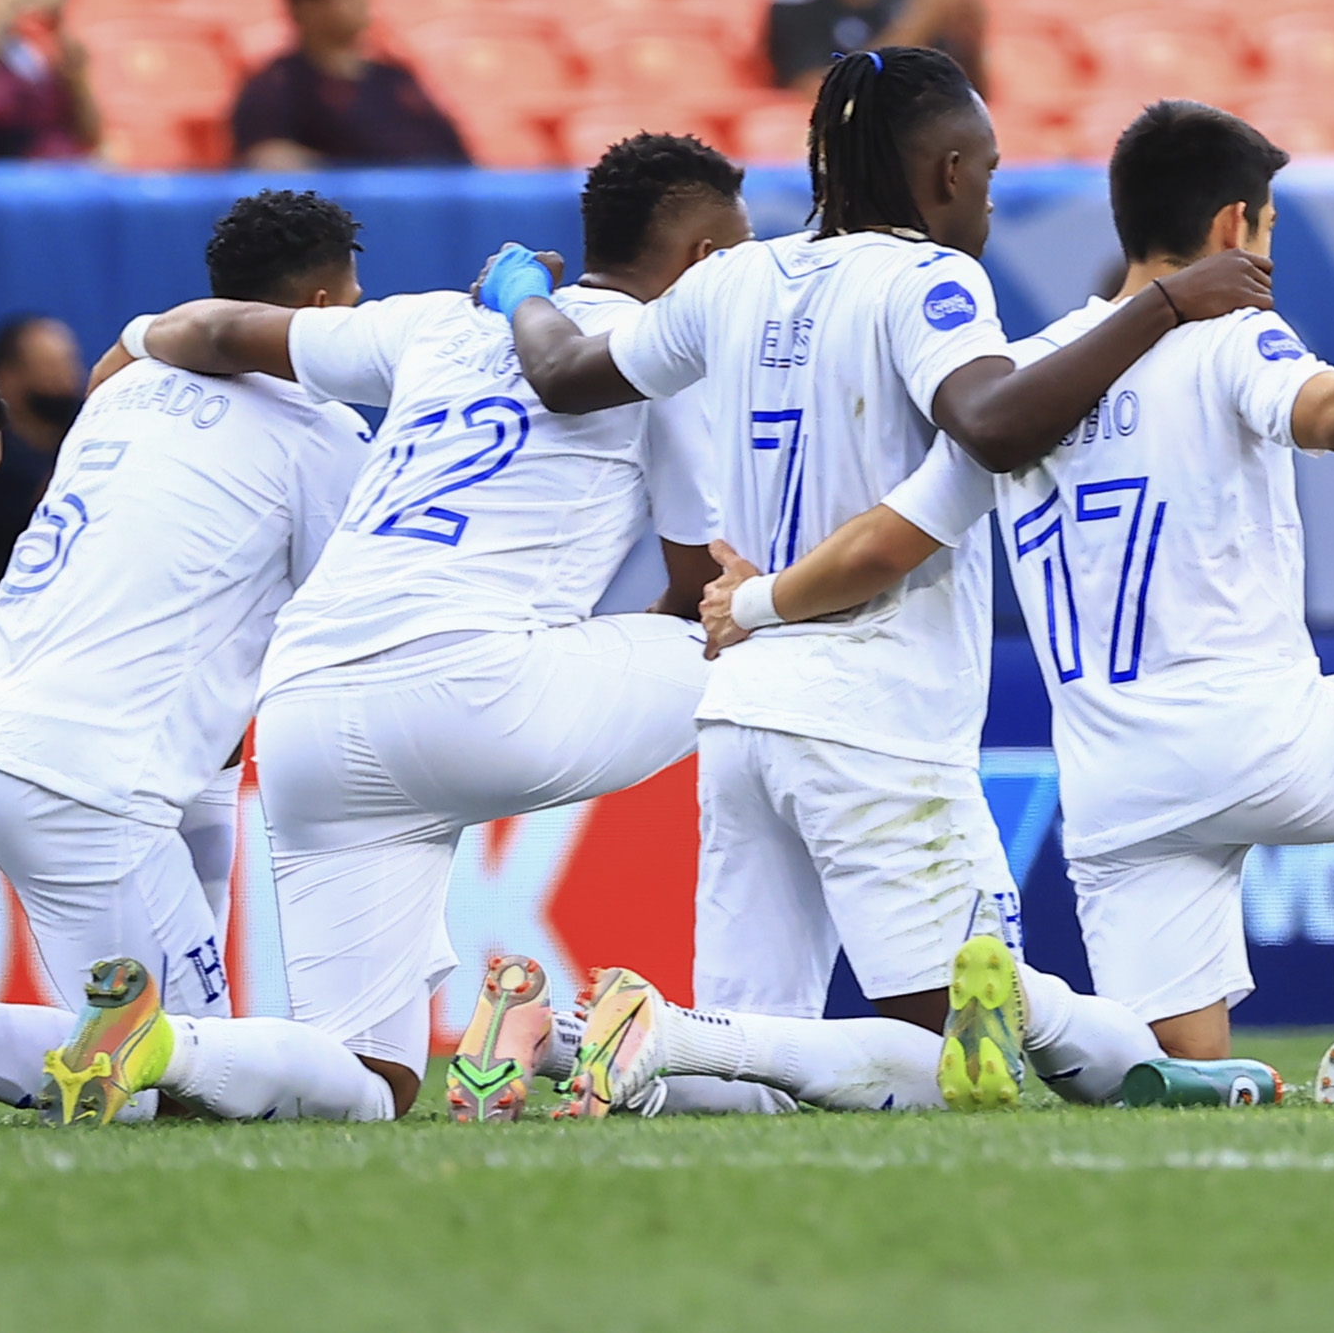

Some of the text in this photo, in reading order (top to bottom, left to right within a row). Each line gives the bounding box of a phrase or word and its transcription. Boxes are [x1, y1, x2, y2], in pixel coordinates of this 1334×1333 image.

[340, 395, 531, 547] 12
[751, 407, 809, 574] 7
[1013, 476, 1168, 684] 17
